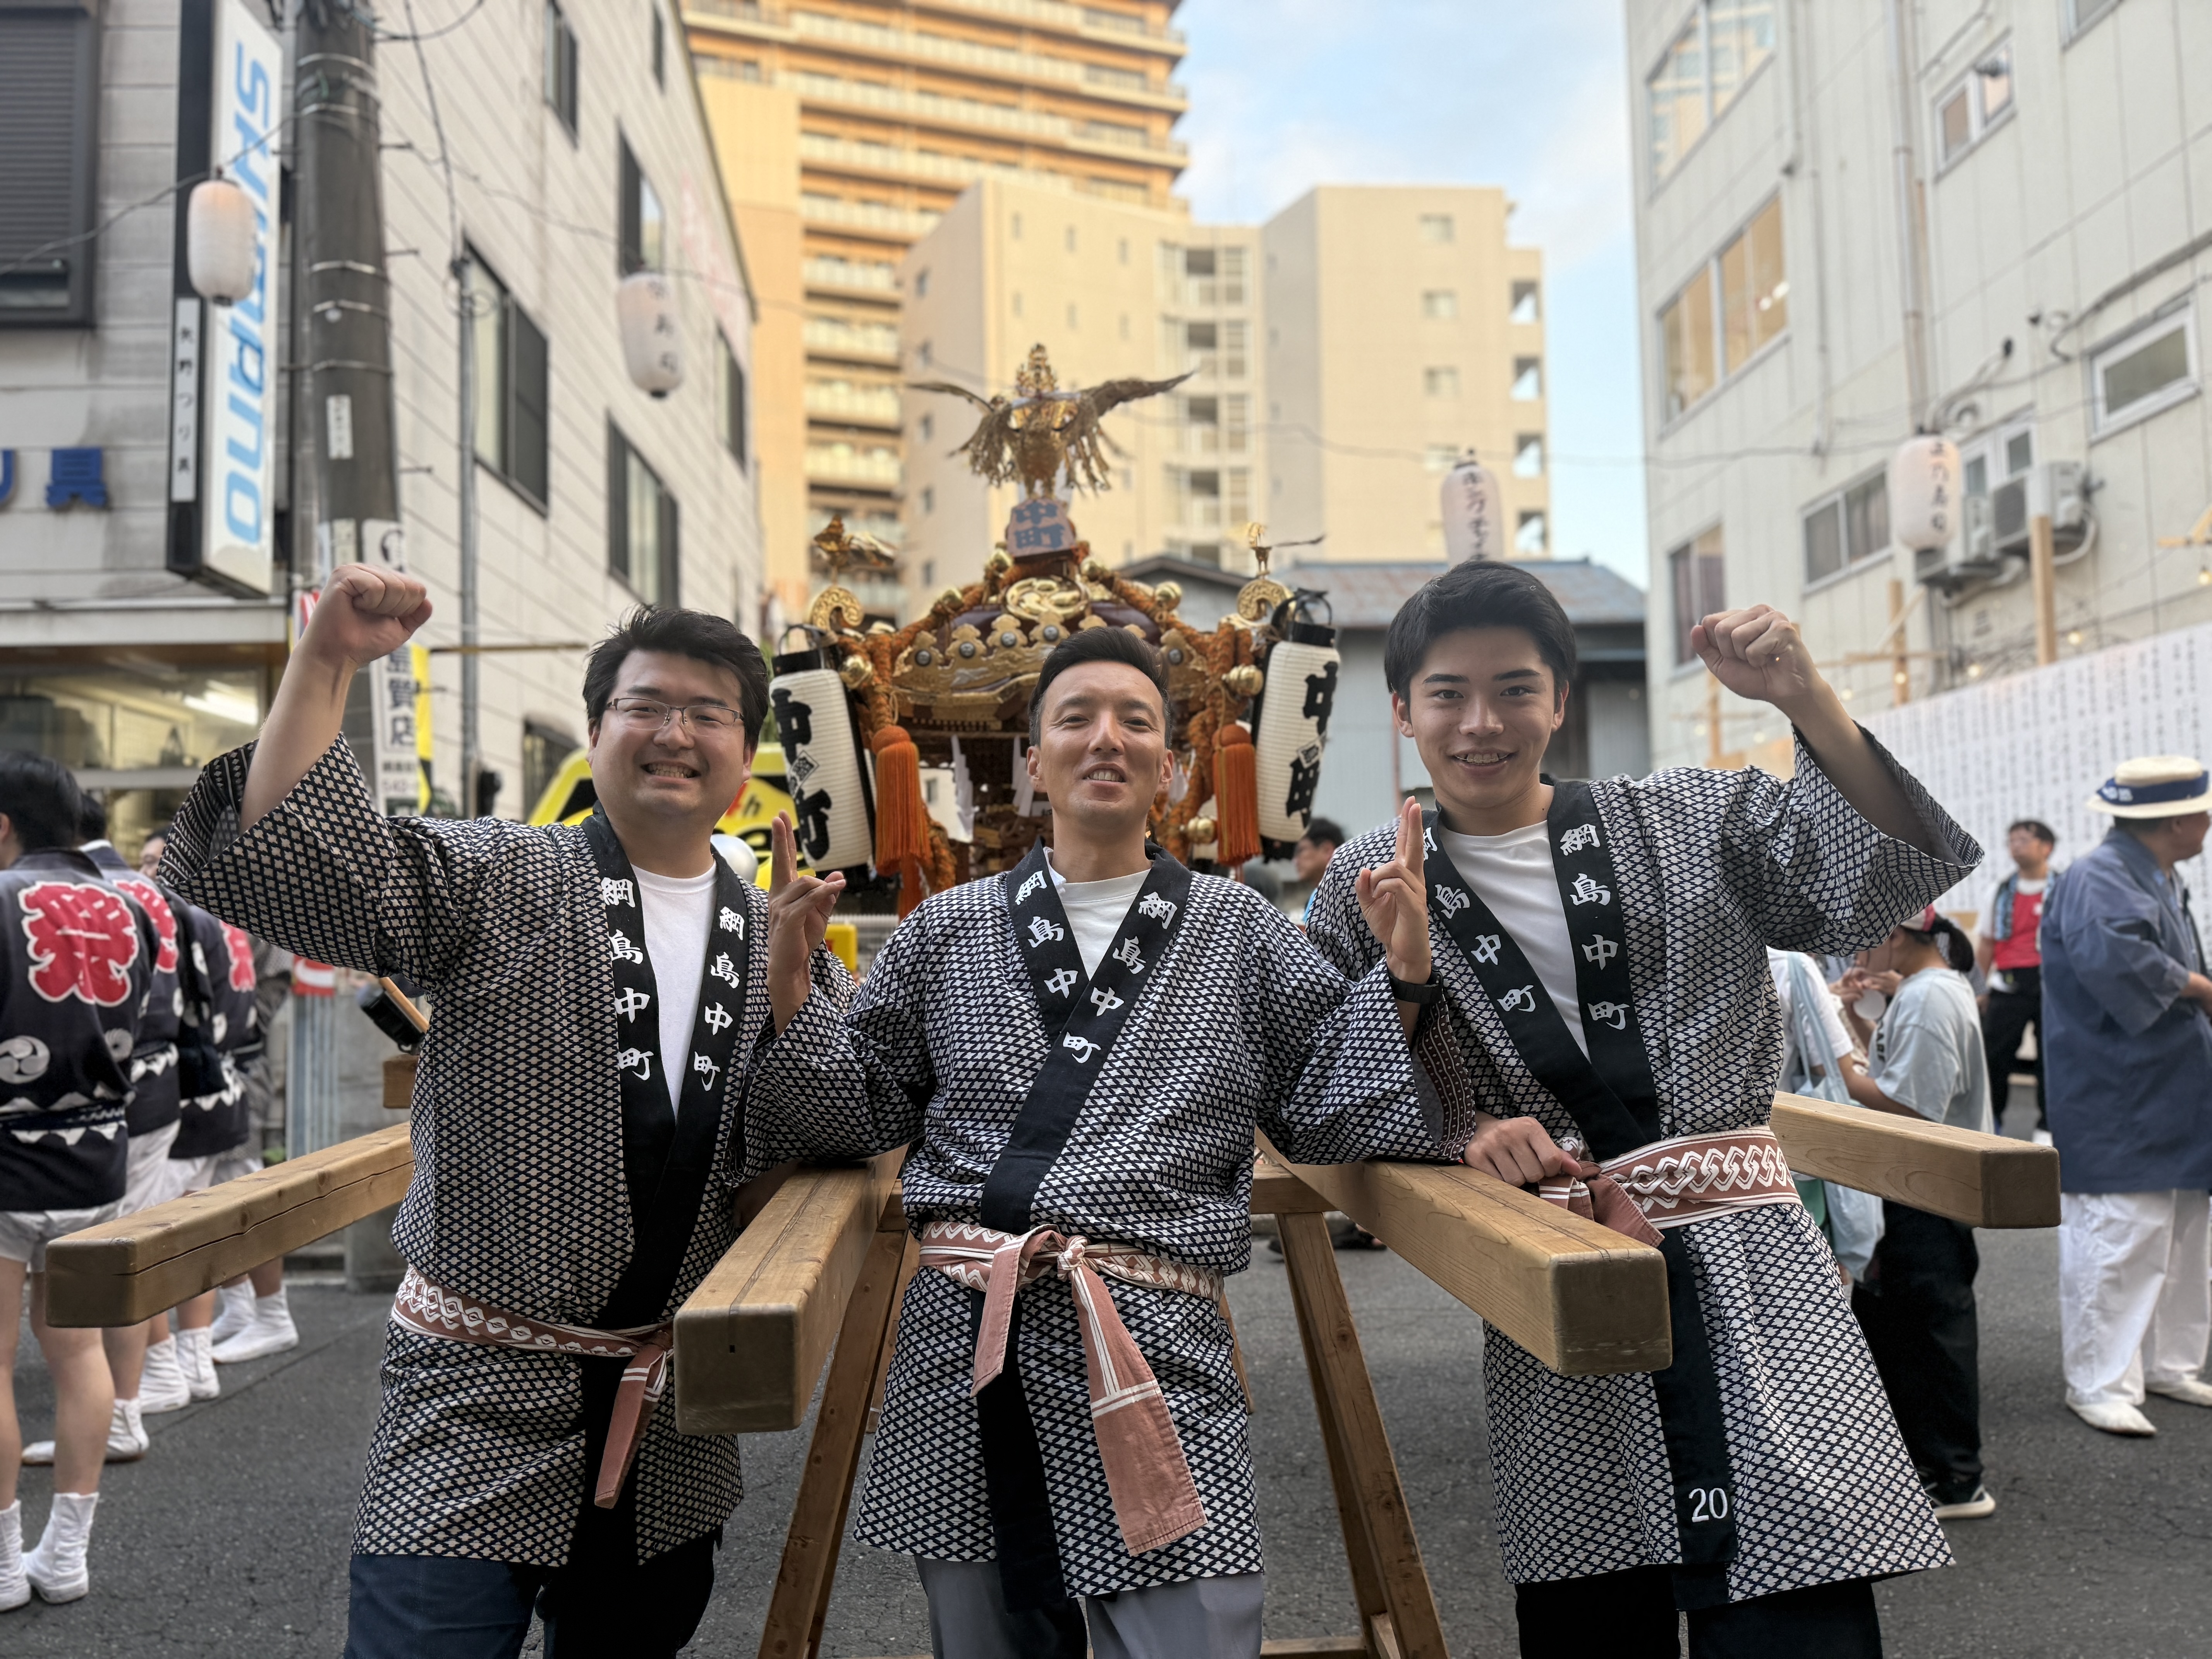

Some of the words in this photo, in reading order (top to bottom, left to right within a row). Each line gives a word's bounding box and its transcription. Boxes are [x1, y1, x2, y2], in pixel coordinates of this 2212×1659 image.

[226, 40, 268, 544] SHANO
[600, 876, 655, 1081] 綱島中町
[694, 906, 745, 1091] 綱島中町
[1062, 891, 1178, 1063] 綱島中町
[1559, 823, 1630, 1030] 綱島中町
[1688, 1487, 1728, 1523] 20
